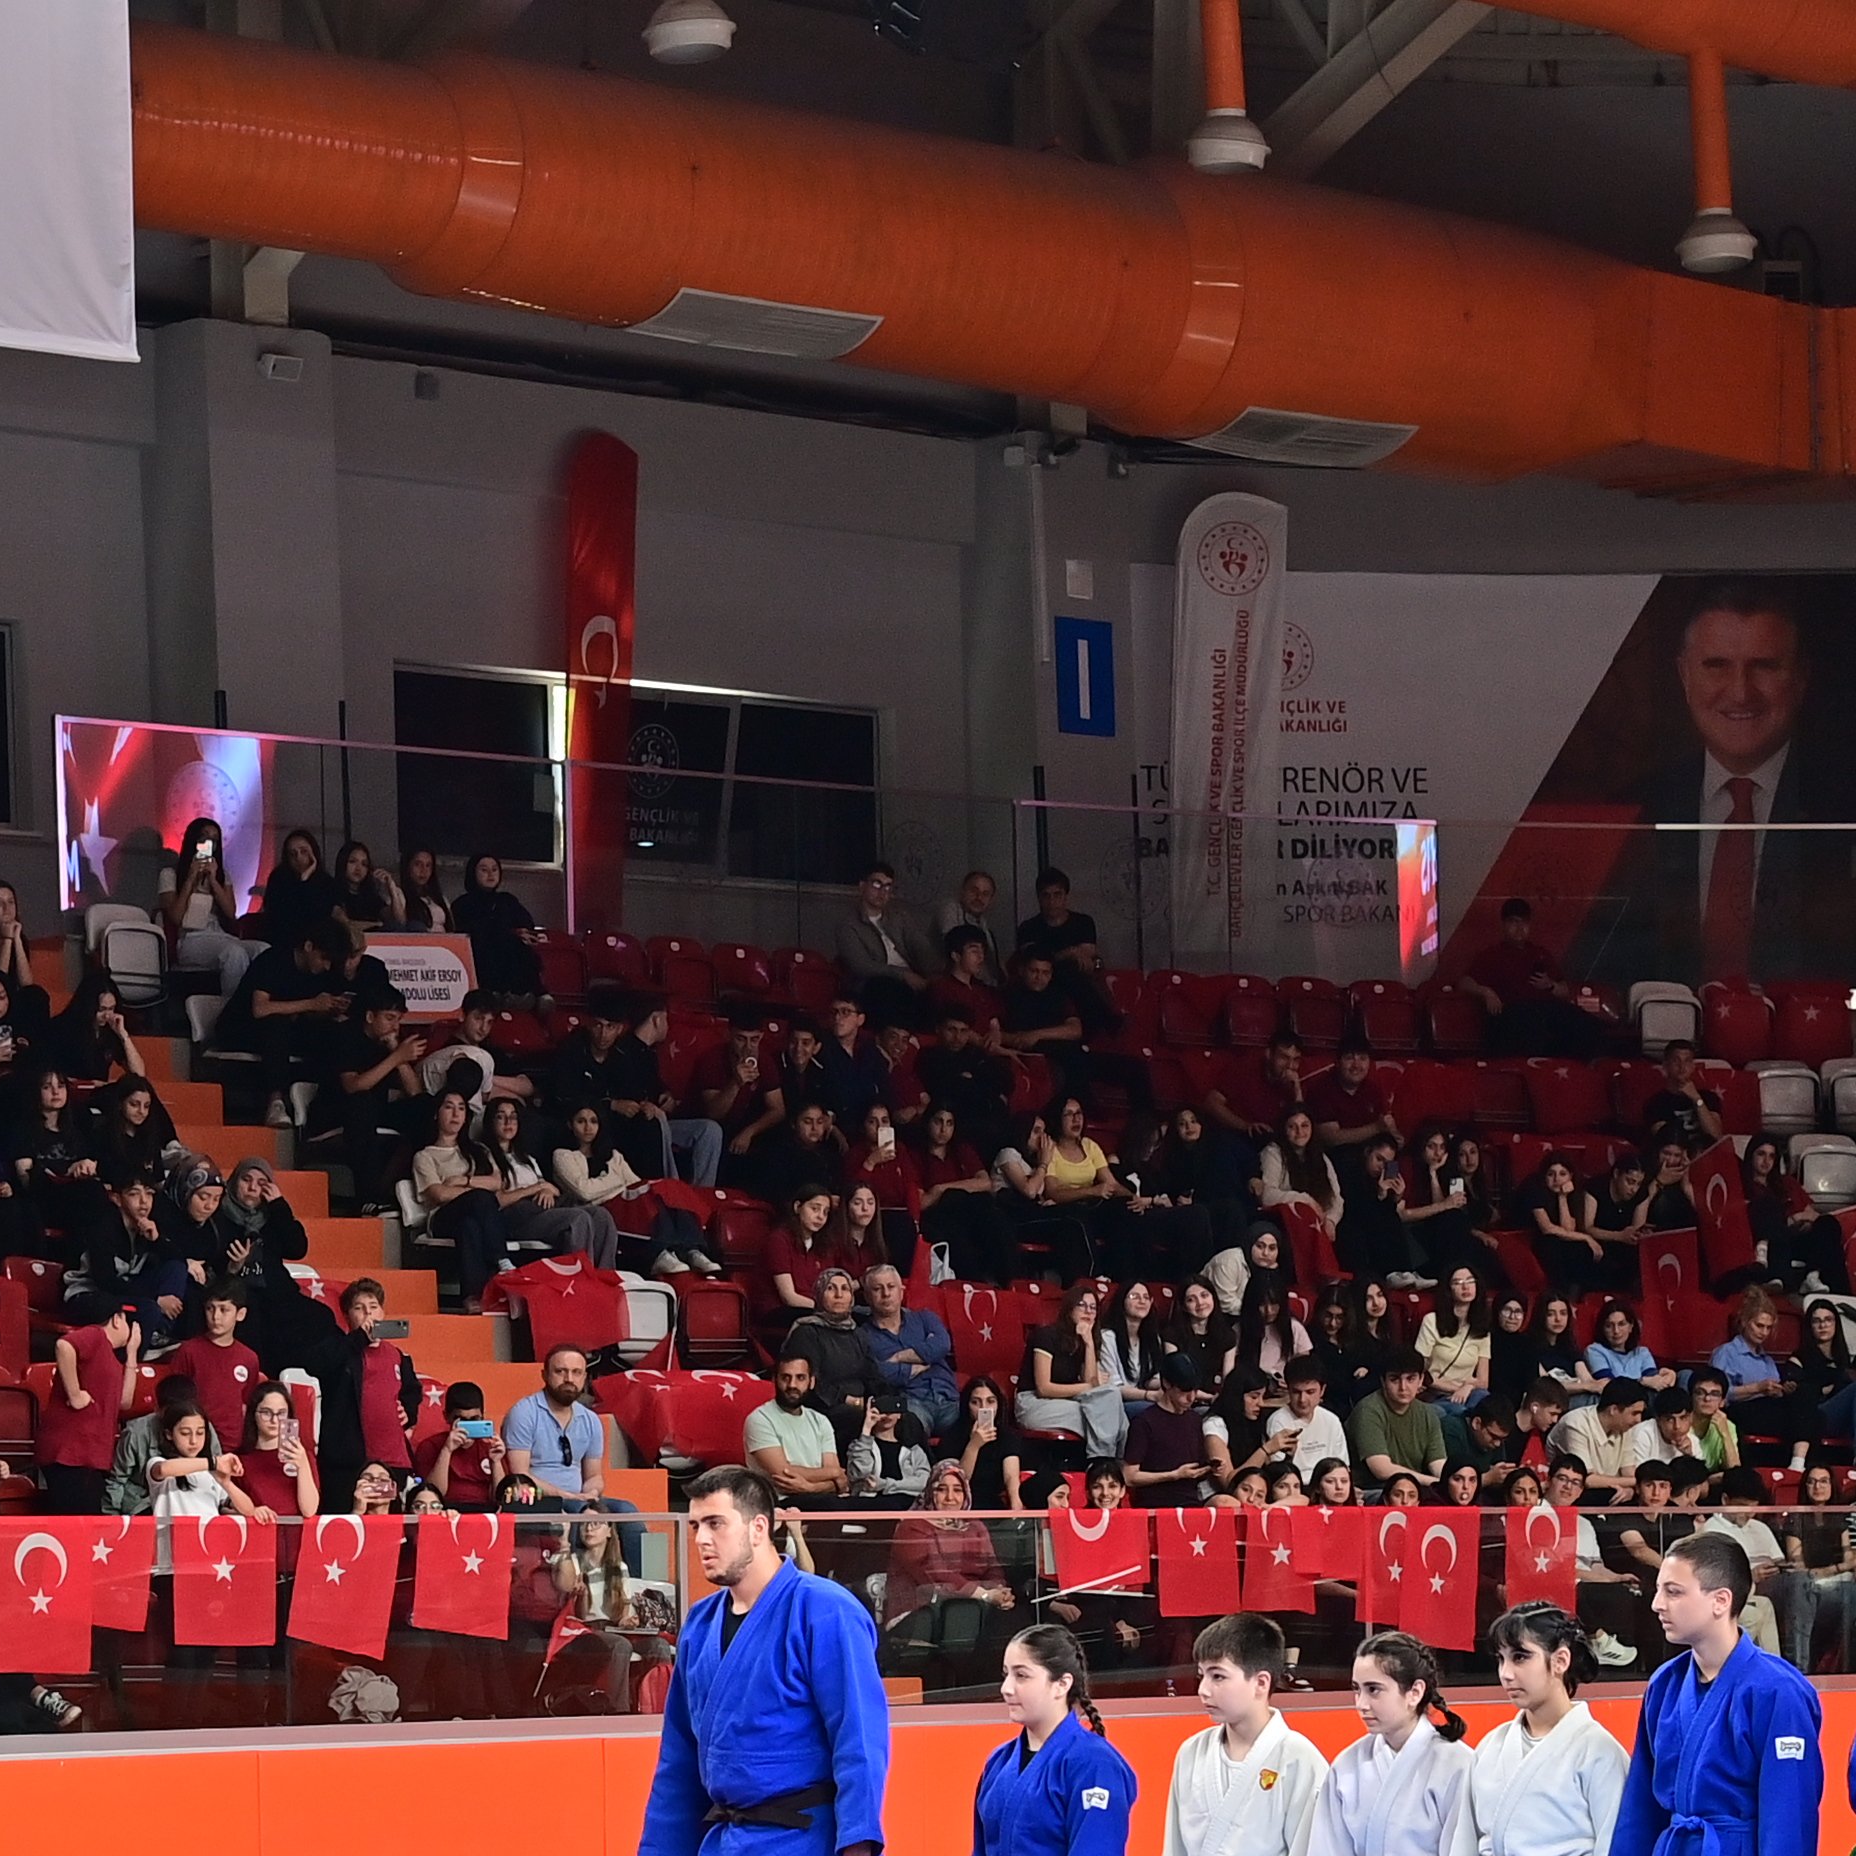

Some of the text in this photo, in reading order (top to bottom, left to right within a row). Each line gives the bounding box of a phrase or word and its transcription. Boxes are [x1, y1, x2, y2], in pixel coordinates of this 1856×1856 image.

[1210, 649, 1226, 732] BAKANLIĞI
[1327, 701, 1347, 714] VE
[1210, 736, 1224, 776] SPOR
[1233, 729, 1245, 763] SPOR
[1210, 780, 1222, 800] VE
[1391, 767, 1428, 793] VE
[1208, 804, 1225, 867] GENÇLK
[1291, 833, 1396, 859] DİLİYOR
[438, 969, 462, 981] ERSOY
